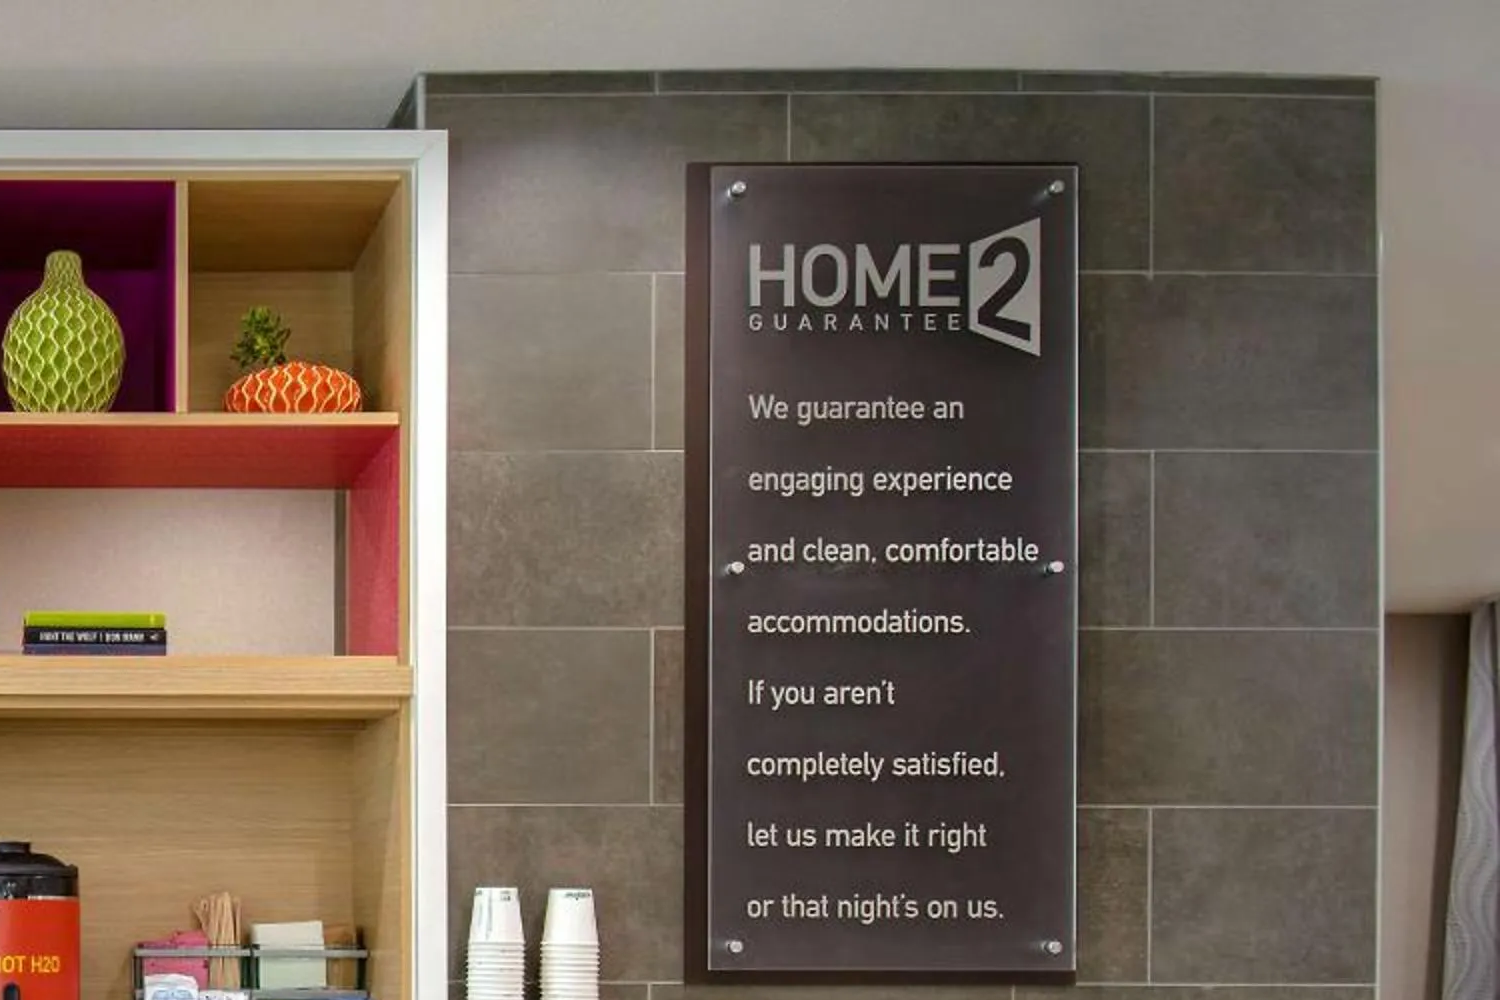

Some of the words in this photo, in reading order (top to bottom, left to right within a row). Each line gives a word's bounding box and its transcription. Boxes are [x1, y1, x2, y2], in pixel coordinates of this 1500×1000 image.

[749, 313, 960, 331] GUARANTEE
[748, 394, 789, 420] We
[797, 396, 925, 426] guarantee
[933, 401, 964, 419] an
[748, 466, 864, 497] engaging
[873, 466, 1013, 497] experience
[747, 536, 795, 563] and
[885, 536, 1039, 563] comfortable
[747, 607, 971, 634] accommodations.
[748, 679, 765, 705] If
[771, 685, 815, 711] you
[823, 679, 895, 705] aren't
[747, 751, 885, 783] completely
[747, 821, 779, 847] let
[786, 828, 817, 847] us
[825, 822, 896, 847] make
[904, 821, 920, 847] it
[928, 821, 987, 854] right
[747, 899, 775, 919] or
[781, 893, 829, 918] that
[837, 893, 919, 925] night's
[927, 899, 958, 919] on
[967, 899, 1004, 919] us.
